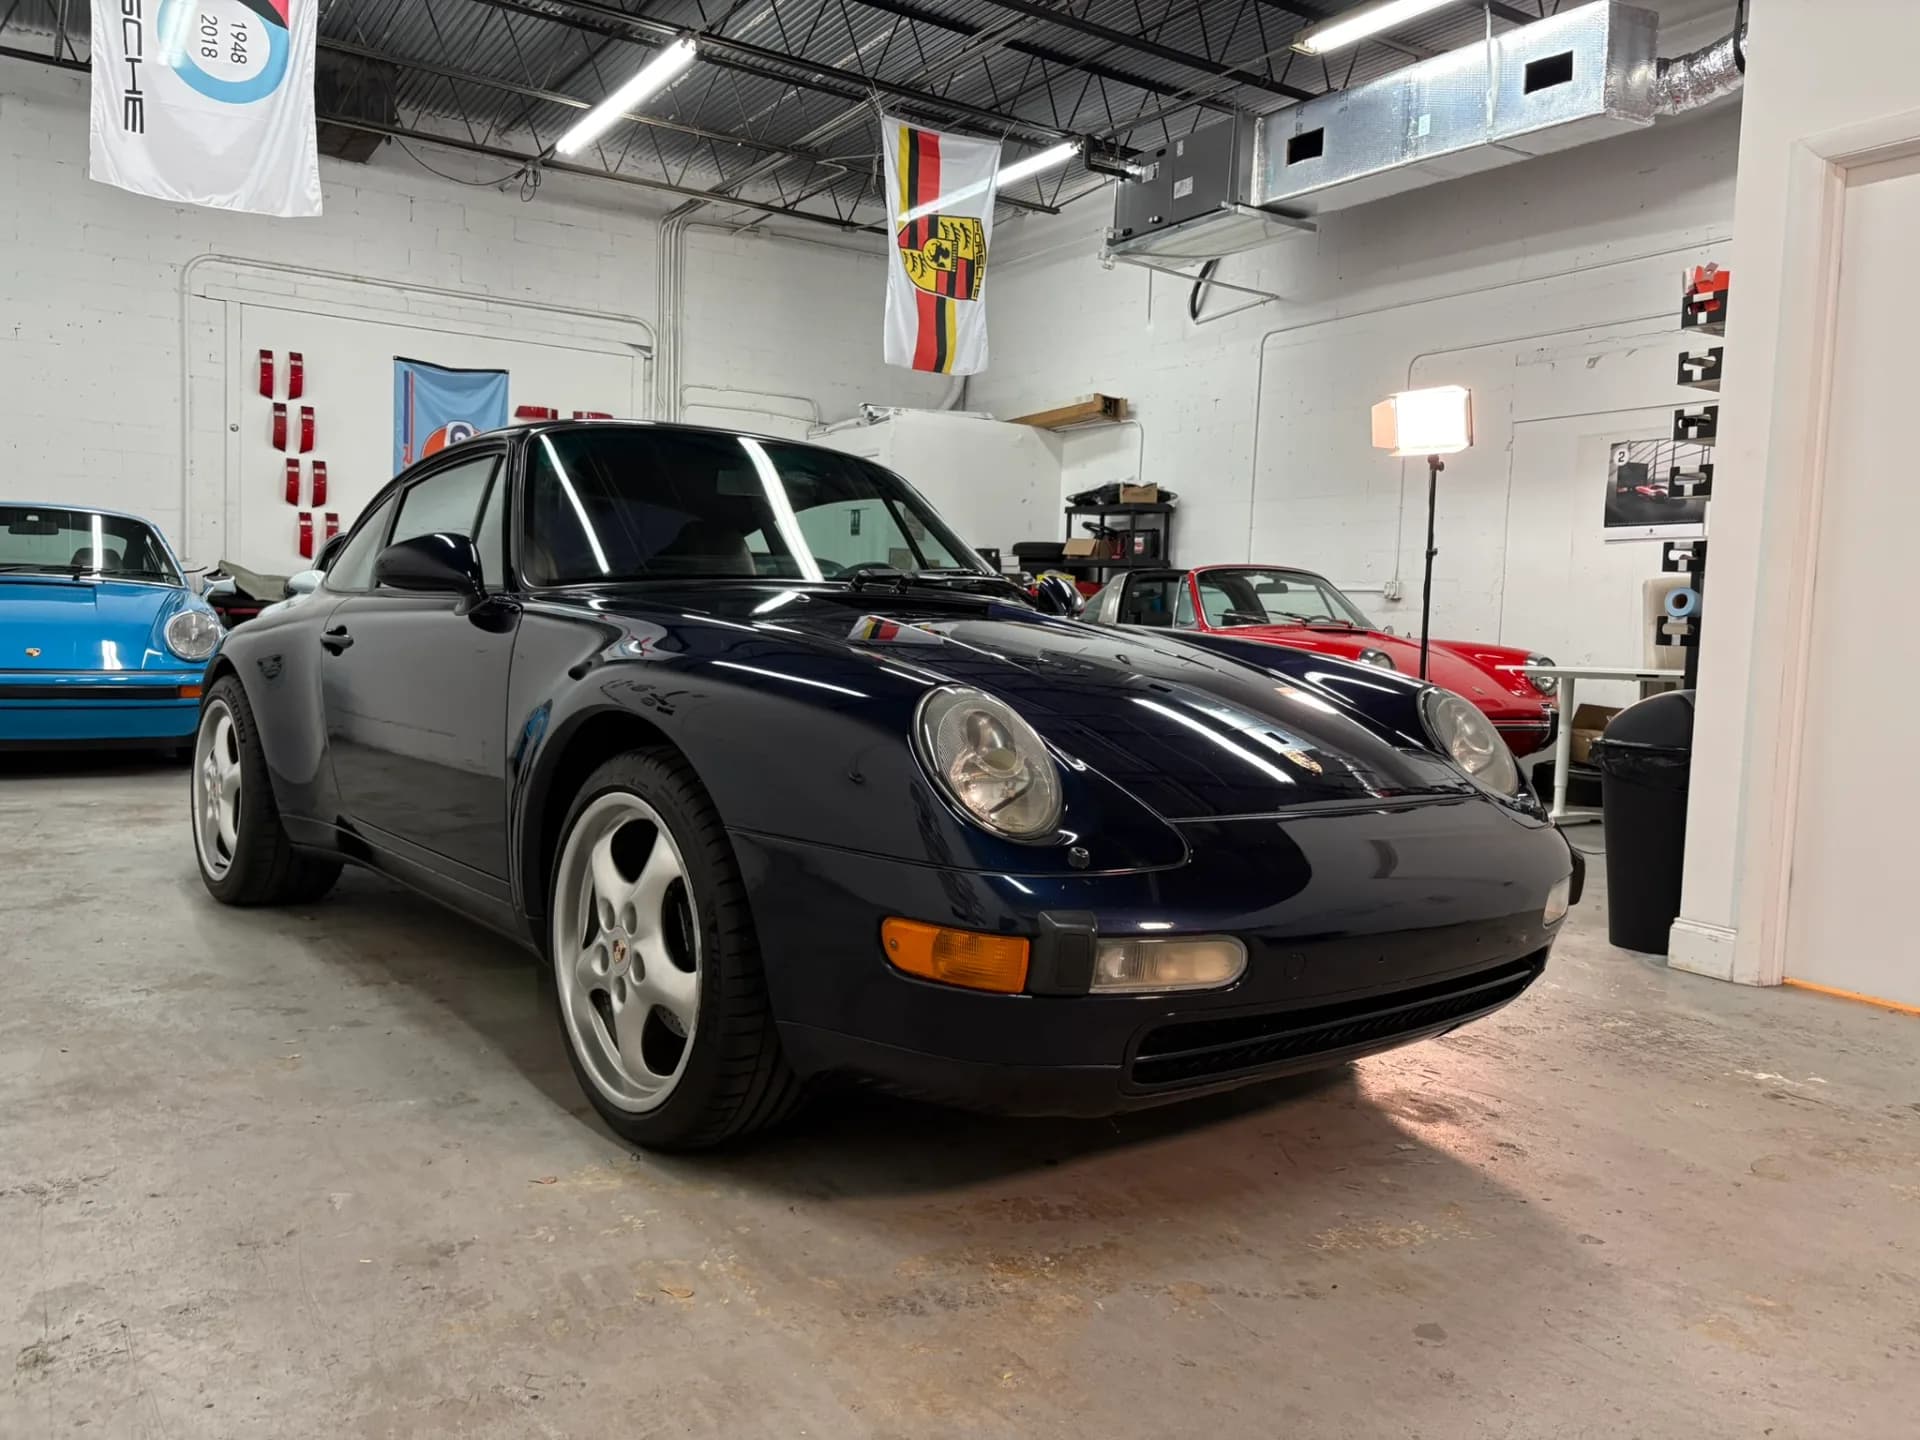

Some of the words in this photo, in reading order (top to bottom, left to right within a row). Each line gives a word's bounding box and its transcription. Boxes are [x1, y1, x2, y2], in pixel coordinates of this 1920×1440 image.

[200, 14, 218, 58] 2018
[230, 22, 248, 64] 1948
[1618, 451, 1625, 462] 2
